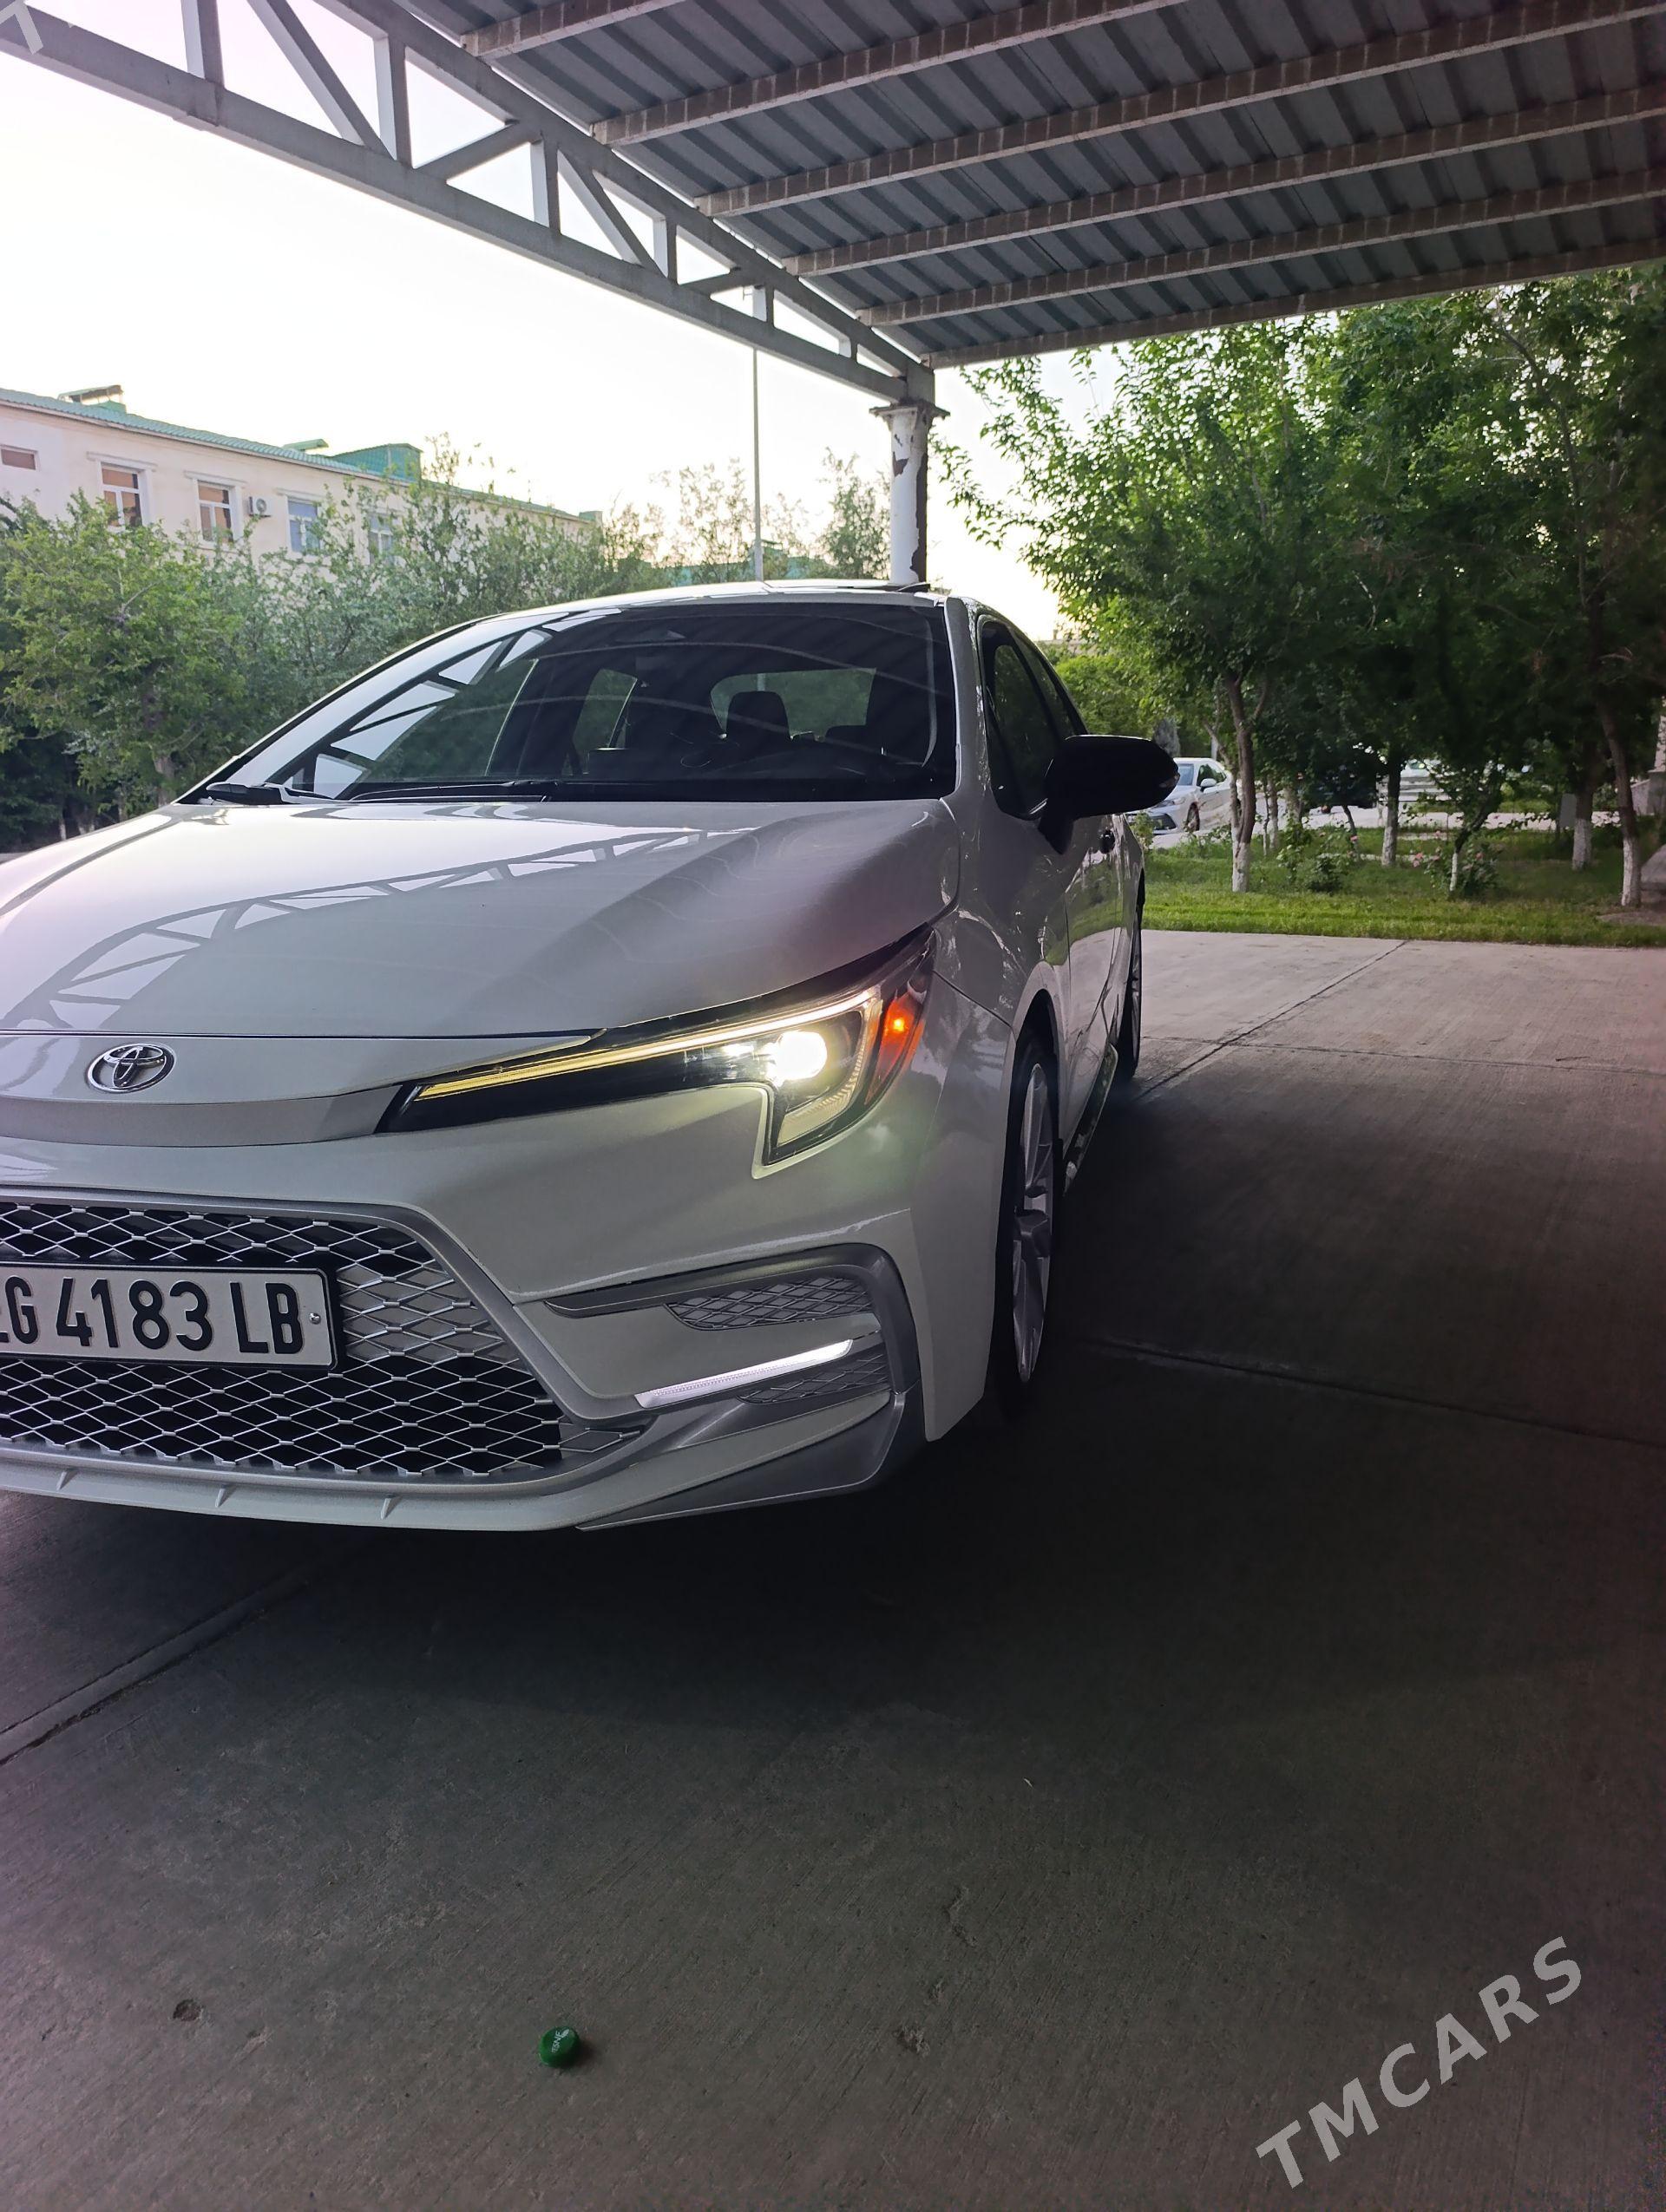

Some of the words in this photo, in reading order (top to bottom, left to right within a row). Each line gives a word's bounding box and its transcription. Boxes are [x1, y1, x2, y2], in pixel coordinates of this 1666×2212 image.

[0, 1276, 39, 1345] G
[56, 1277, 213, 1351] 4183
[230, 1282, 305, 1354] LB
